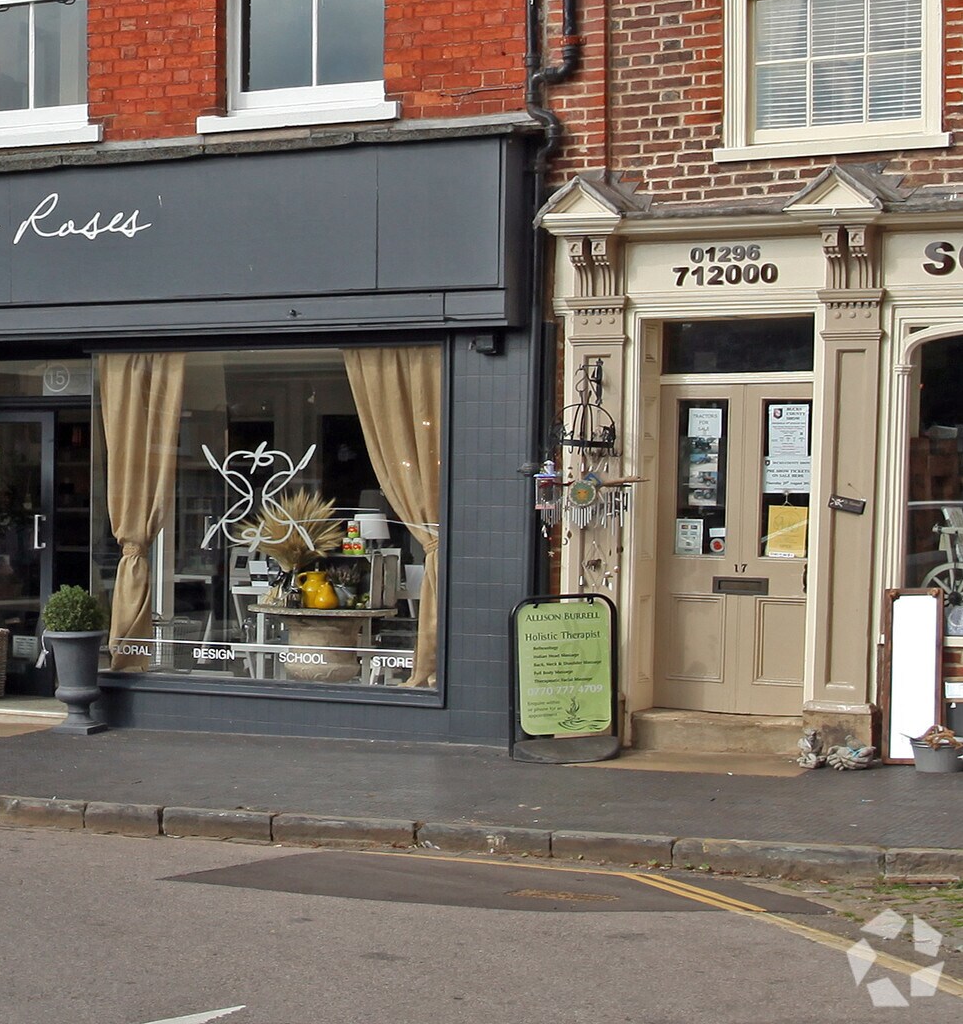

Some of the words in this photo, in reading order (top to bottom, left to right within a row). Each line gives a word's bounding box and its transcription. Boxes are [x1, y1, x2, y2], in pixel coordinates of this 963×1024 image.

[13, 193, 152, 245] Roses
[690, 244, 761, 263] 01296
[923, 241, 963, 276] S
[673, 263, 779, 286] 712000
[49, 370, 65, 385] 15
[734, 564, 747, 573] 17
[526, 613, 561, 622] ALLISON
[564, 612, 600, 620] BURRELL
[525, 632, 558, 641] Holistic
[561, 630, 601, 640] Therapist
[112, 644, 152, 656] FLORAL
[193, 648, 235, 661] DESIGN
[279, 652, 327, 665] SCHOOL
[373, 656, 414, 668] STORE
[556, 685, 575, 694] 777
